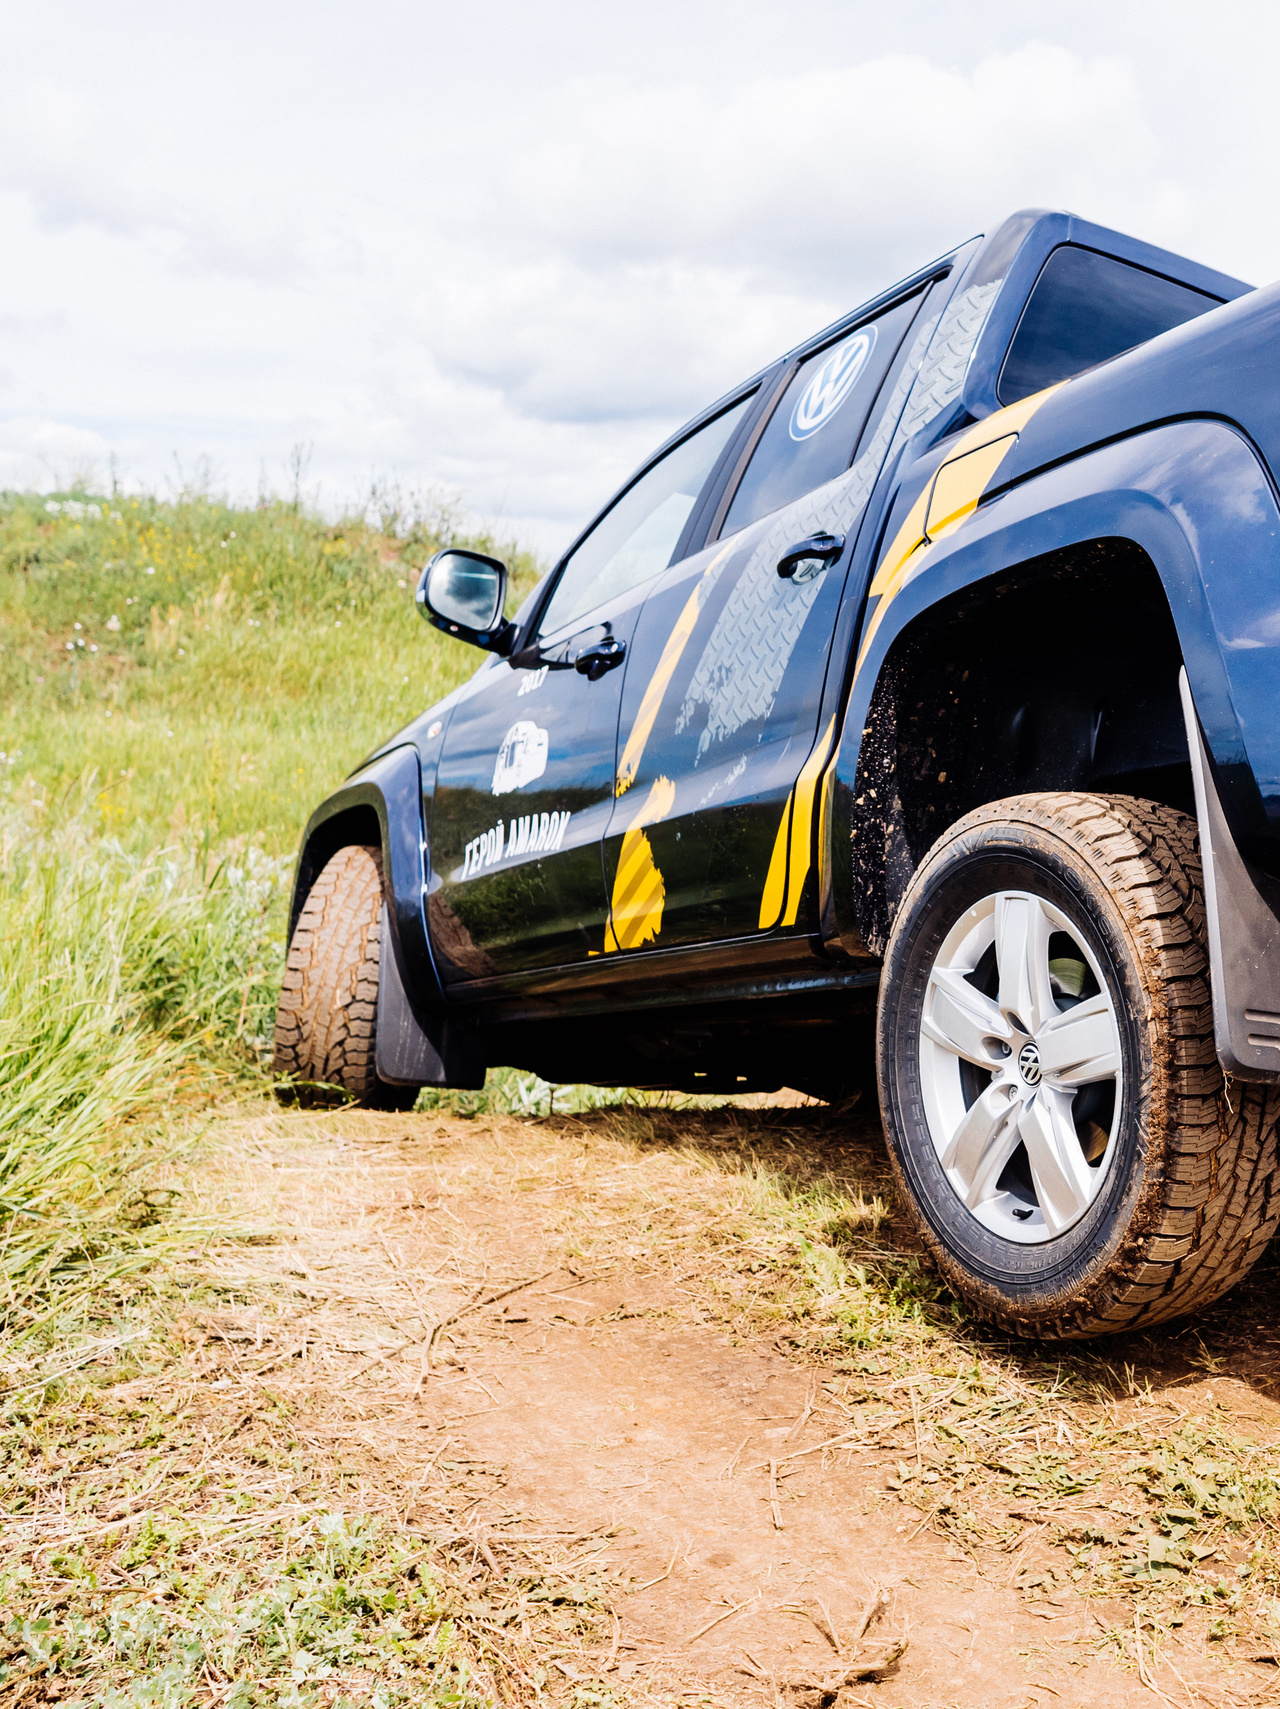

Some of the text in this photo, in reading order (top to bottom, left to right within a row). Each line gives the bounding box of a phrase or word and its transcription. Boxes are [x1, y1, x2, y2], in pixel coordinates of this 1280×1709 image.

[517, 664, 549, 697] 2017
[461, 811, 571, 881] ГЕРОЙ AMAROK
